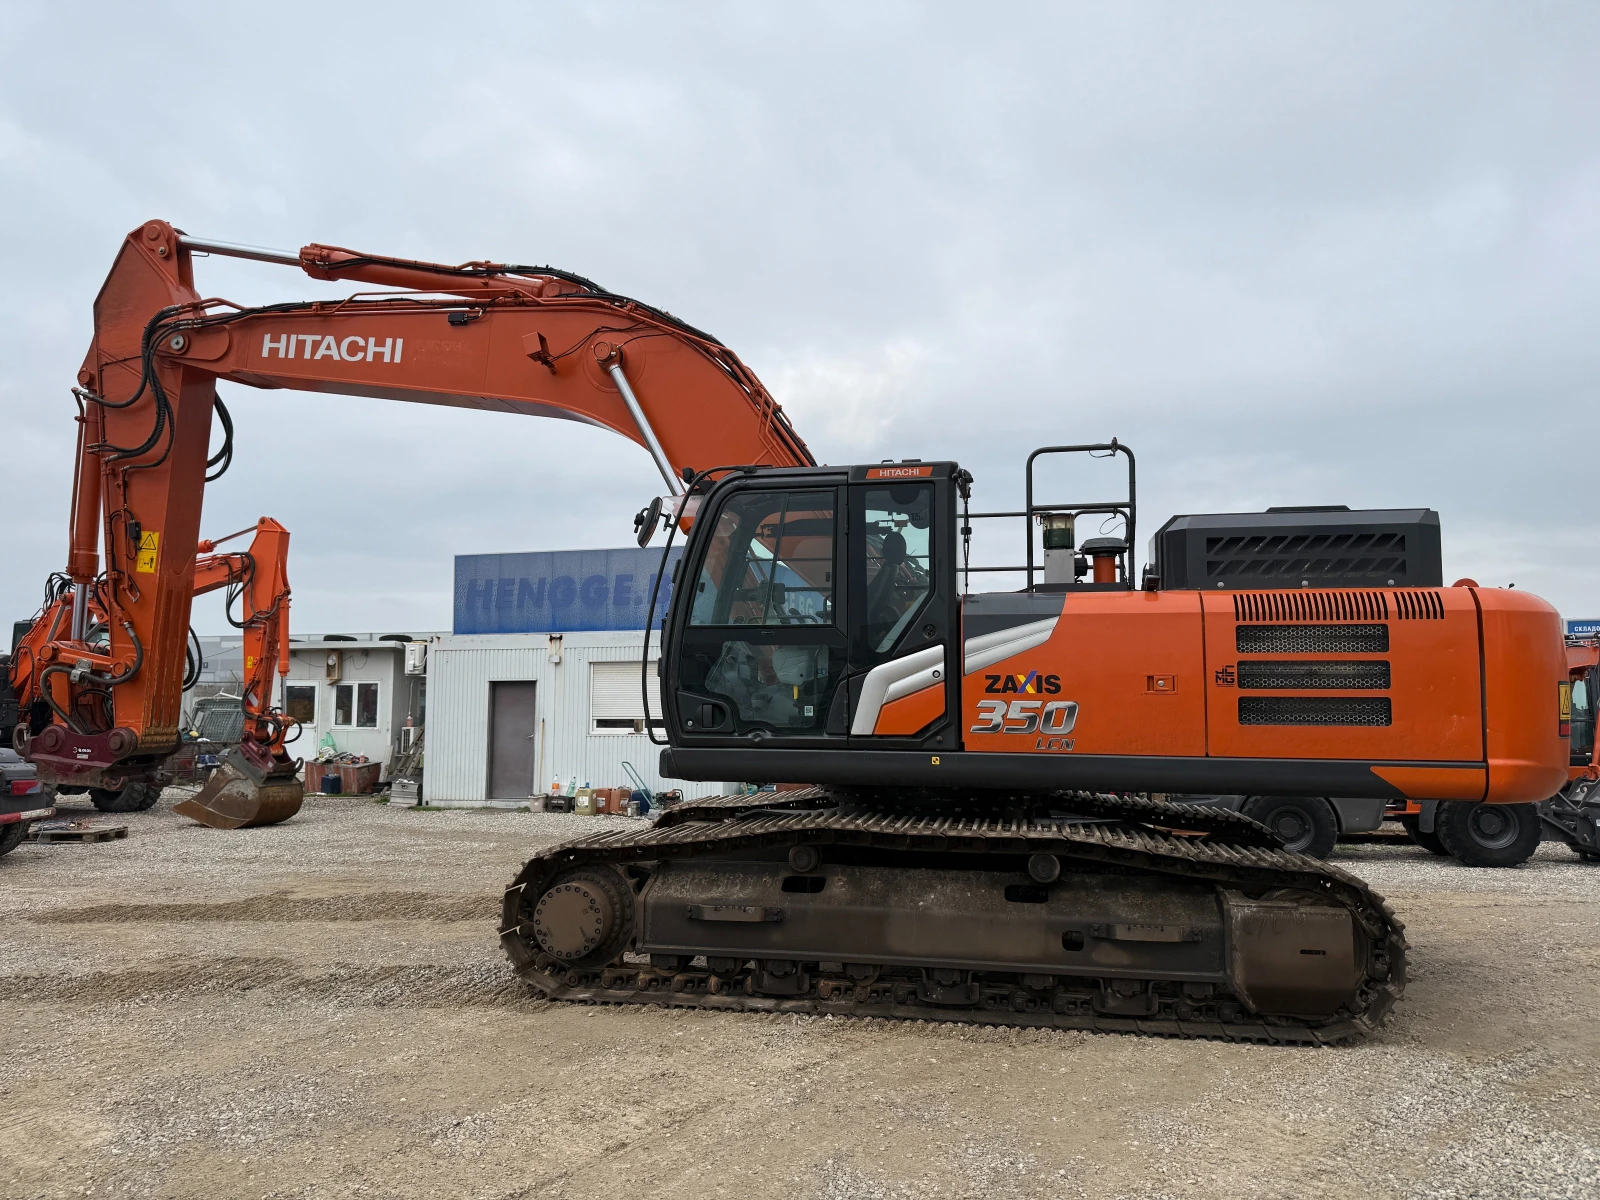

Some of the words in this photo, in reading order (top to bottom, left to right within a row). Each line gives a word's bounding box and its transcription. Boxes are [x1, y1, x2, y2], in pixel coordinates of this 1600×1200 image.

[261, 333, 404, 363] HITACHI
[879, 468, 920, 477] HITACHI
[985, 670, 1061, 694] ZAXIS
[970, 699, 1079, 735] 350
[1035, 737, 1075, 750] LCN
